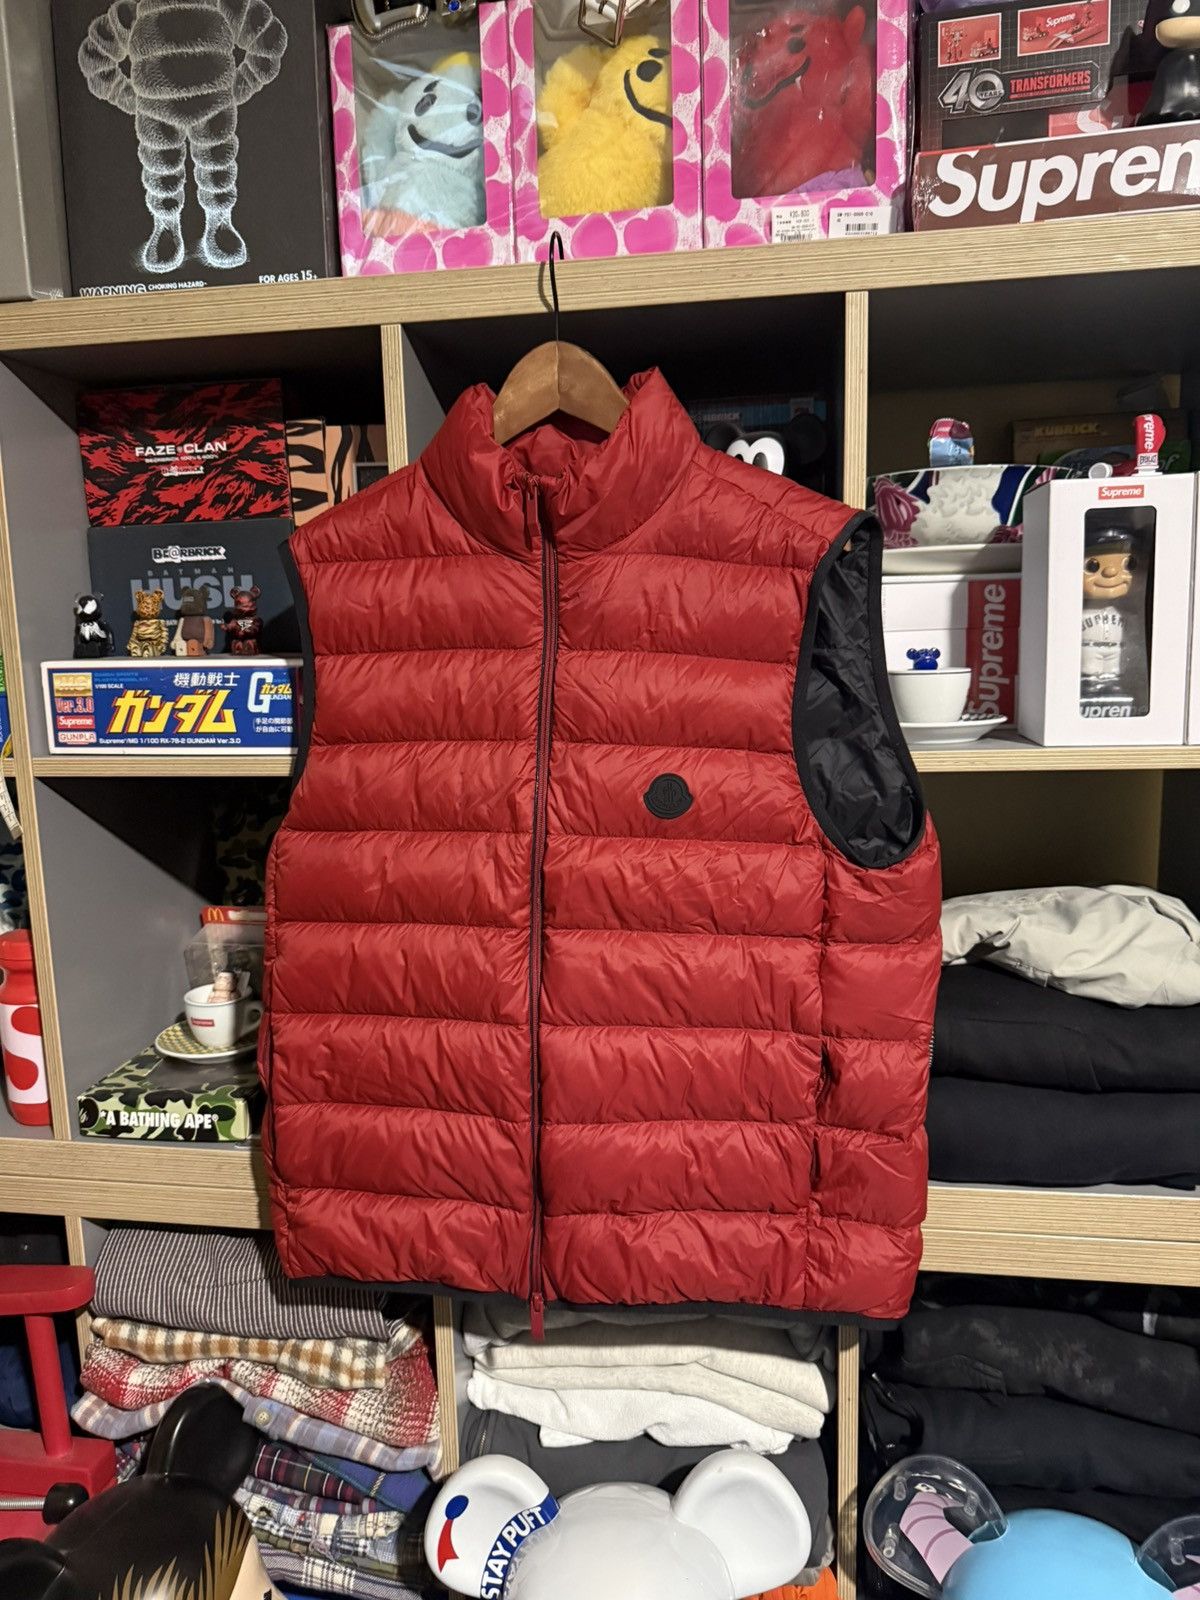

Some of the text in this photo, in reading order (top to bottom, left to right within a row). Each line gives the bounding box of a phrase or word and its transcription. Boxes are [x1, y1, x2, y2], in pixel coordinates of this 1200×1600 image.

[1046, 13, 1076, 28] Supreme
[1009, 70, 1091, 93] TRANSFORMERS
[258, 275, 275, 284] FOR
[277, 273, 299, 282] AGES
[79, 284, 147, 298] WARNING
[147, 283, 177, 291] CHOKING
[135, 441, 227, 457] FAZE CLAN
[1100, 486, 1143, 498] Supreme
[967, 584, 1010, 718] Supreme
[173, 672, 240, 688] 機動戦士
[106, 689, 238, 734] ガンダム
[59, 716, 93, 728] Supreme
[60, 732, 96, 741] GUNPLA
[120, 1111, 181, 1128] BATHING
[481, 1506, 546, 1600] STAY PUFT
